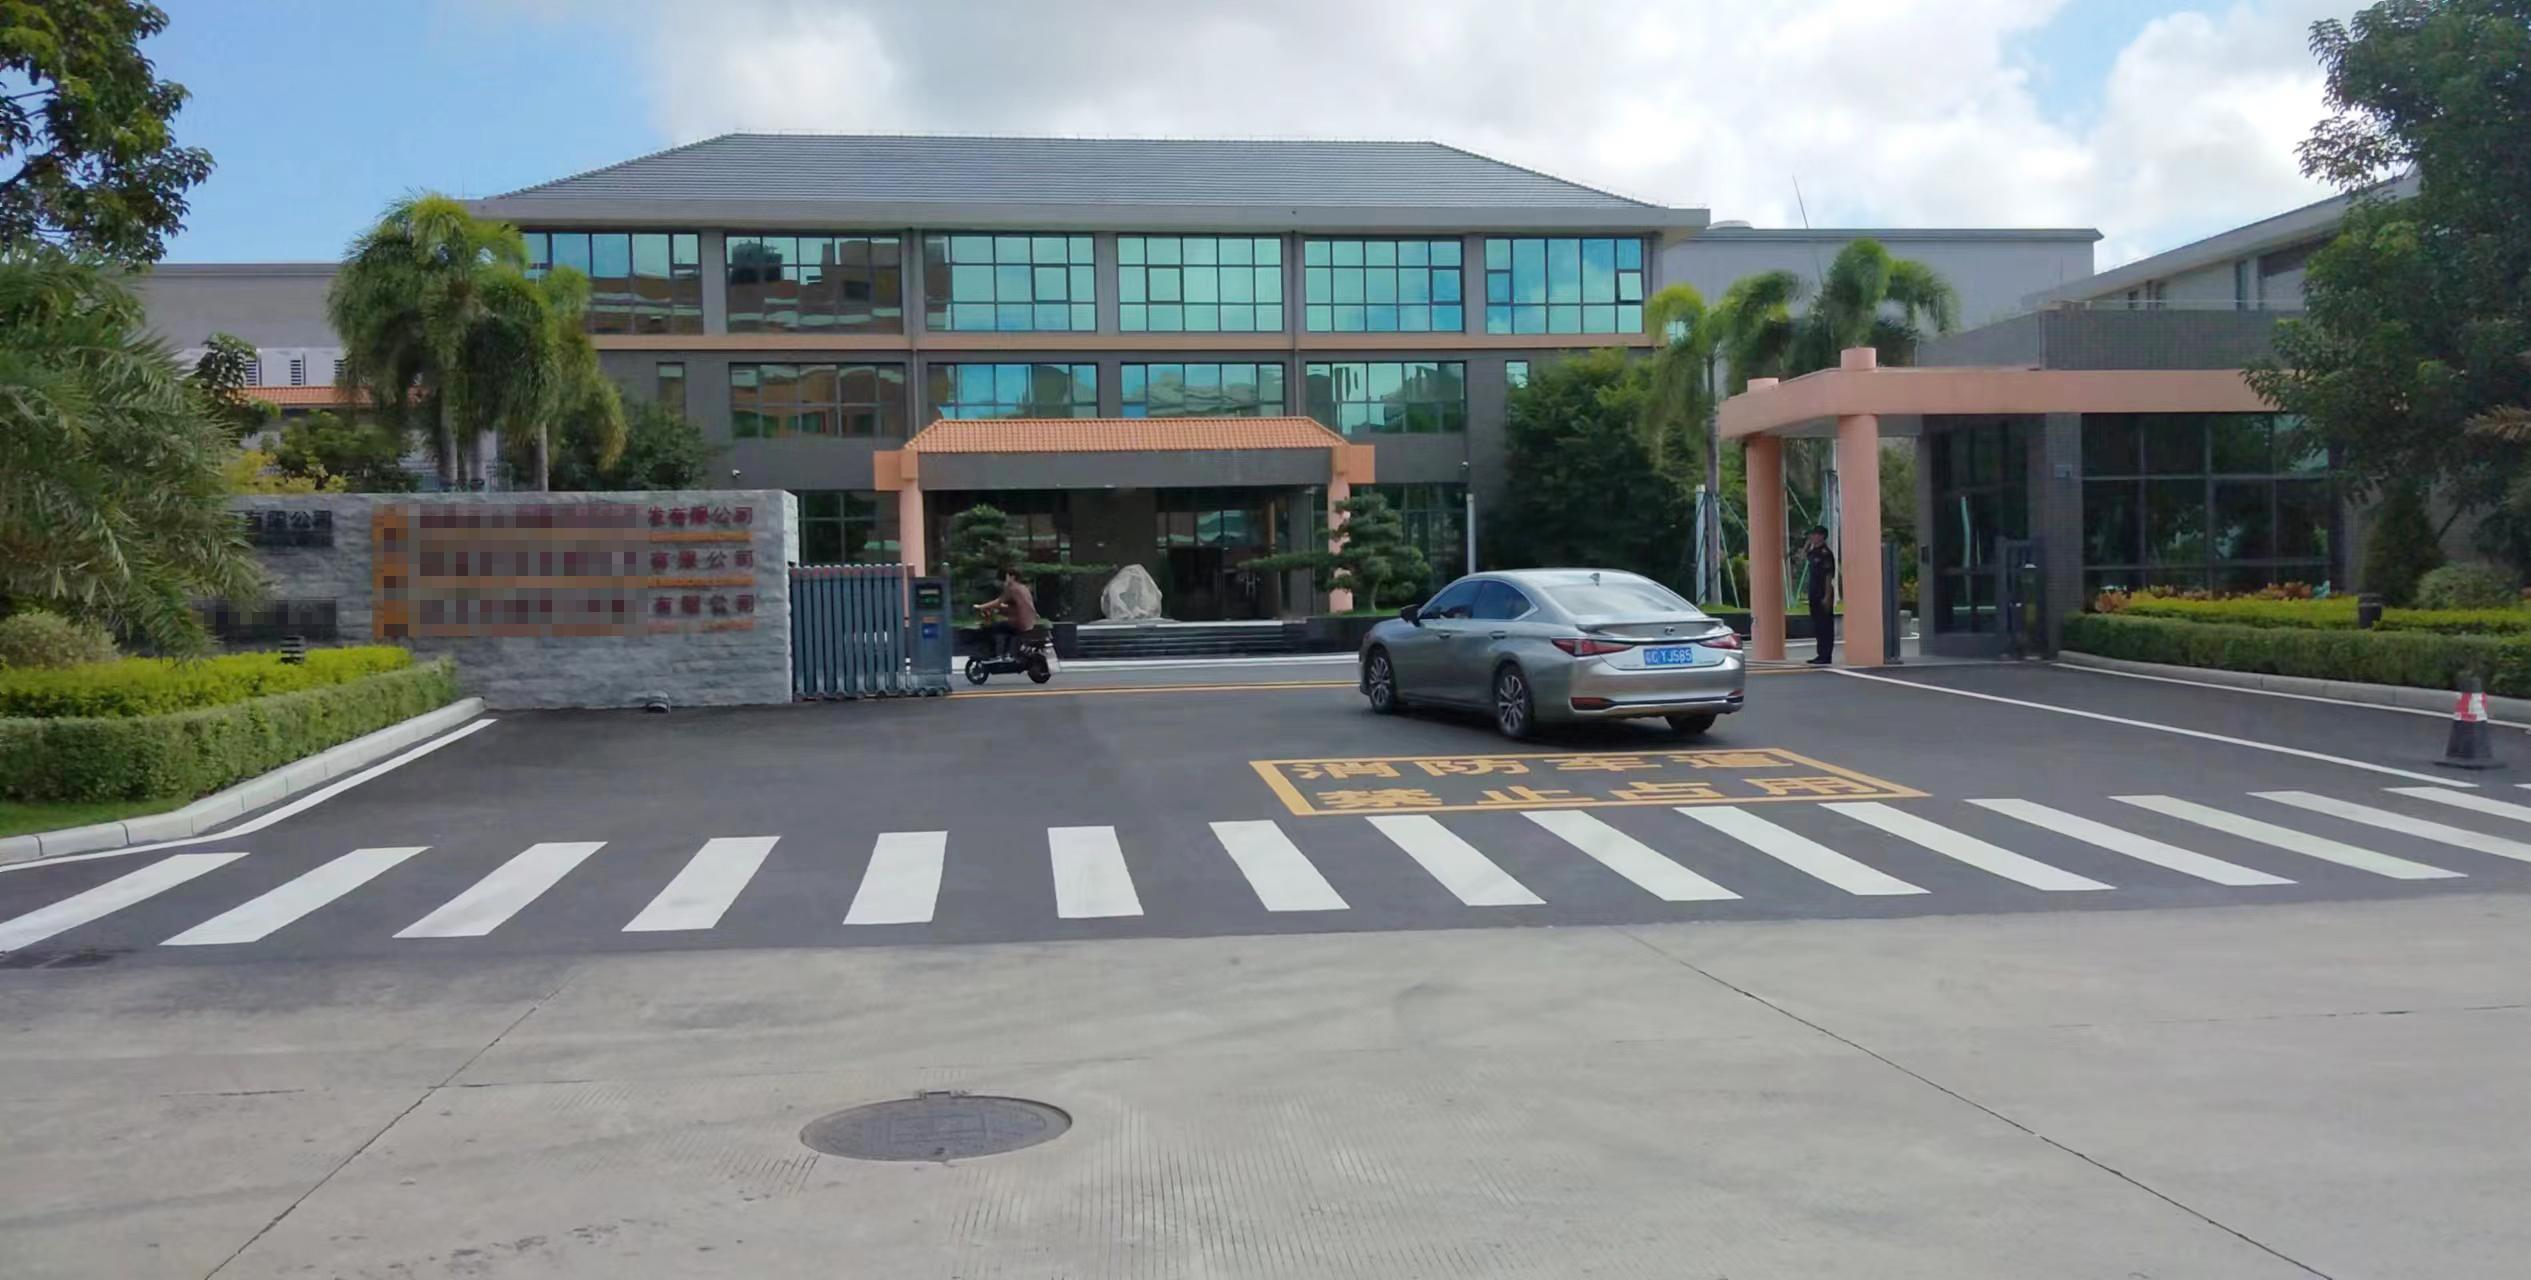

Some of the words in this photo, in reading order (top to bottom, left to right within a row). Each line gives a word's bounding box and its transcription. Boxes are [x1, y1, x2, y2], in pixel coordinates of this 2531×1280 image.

[1291, 753, 1794, 779] 消防车道
[1316, 776, 1878, 806] 禁止占用
